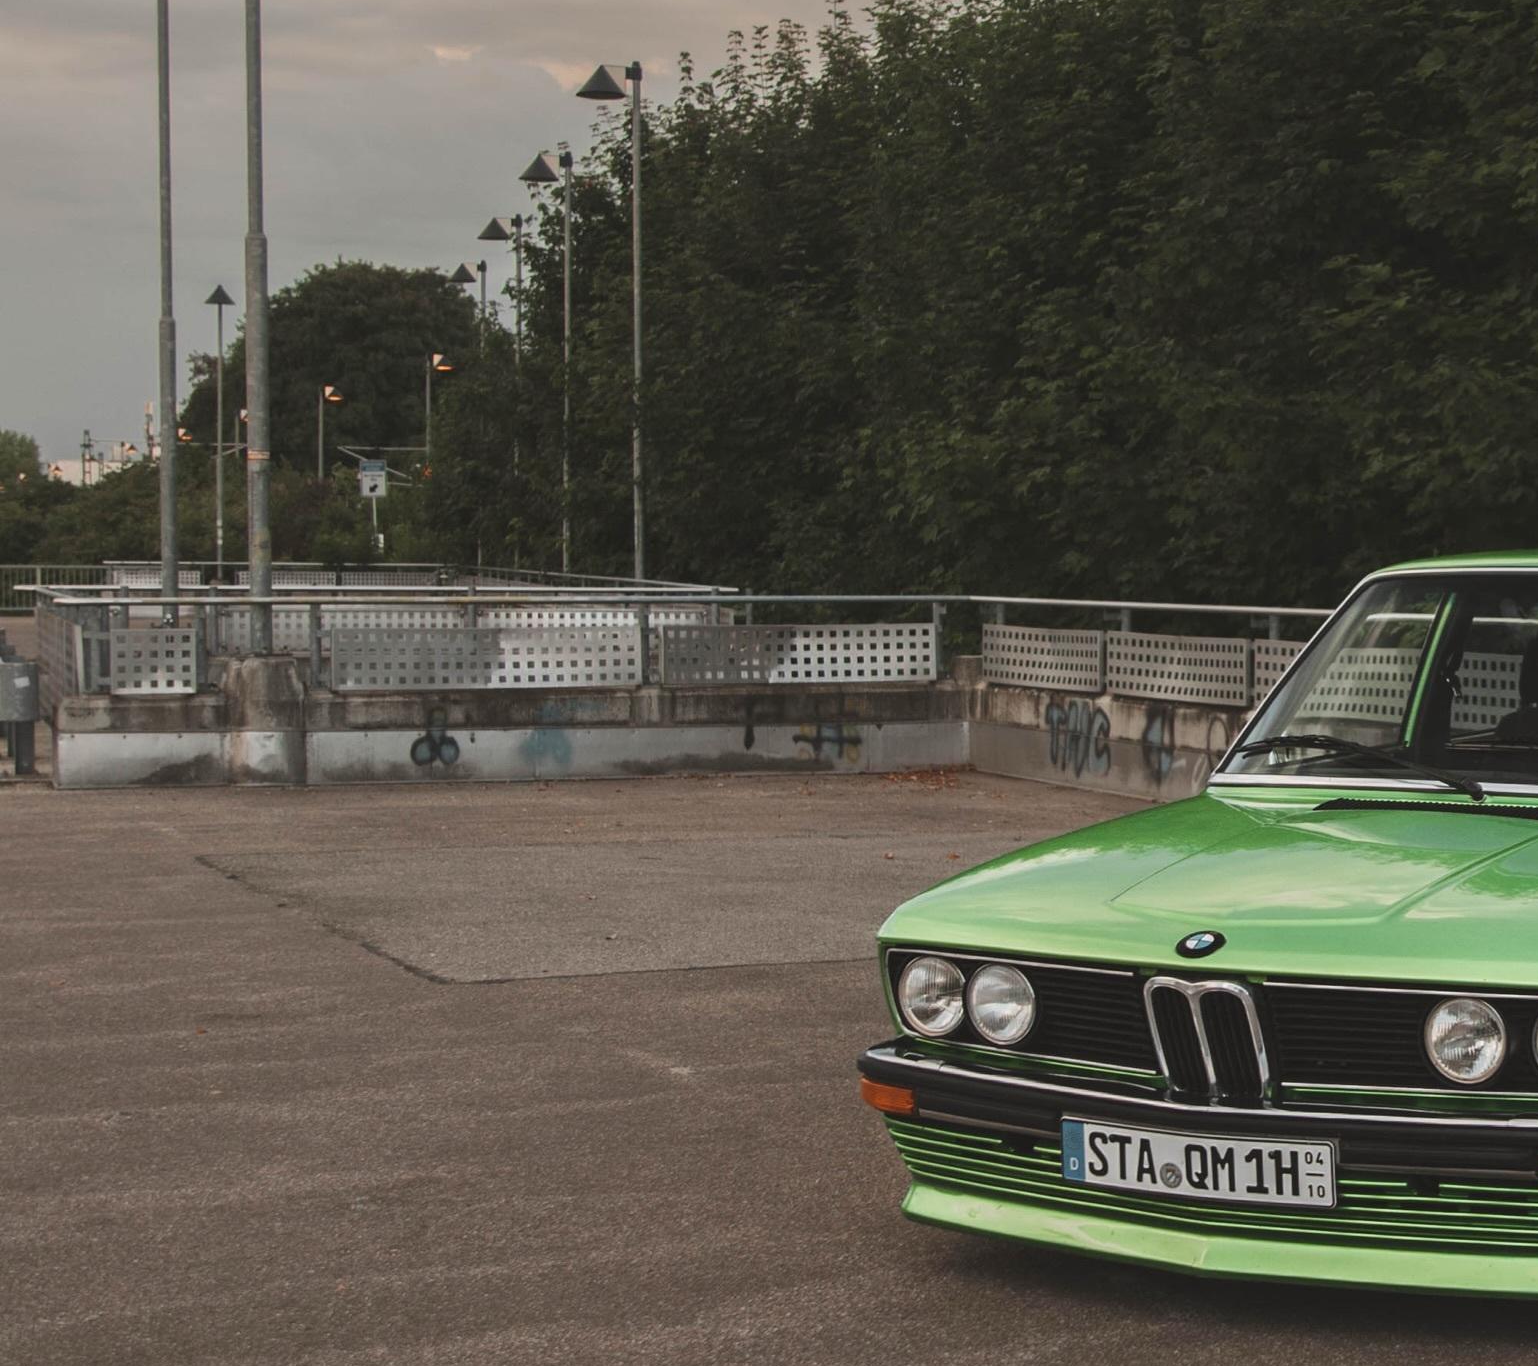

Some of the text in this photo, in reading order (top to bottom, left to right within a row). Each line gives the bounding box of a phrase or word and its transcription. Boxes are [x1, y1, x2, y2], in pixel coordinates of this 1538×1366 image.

[1069, 1157, 1079, 1171] D
[1088, 1131, 1300, 1197] STA QM 1H
[1304, 1151, 1324, 1165] 04
[1308, 1184, 1326, 1199] 10
